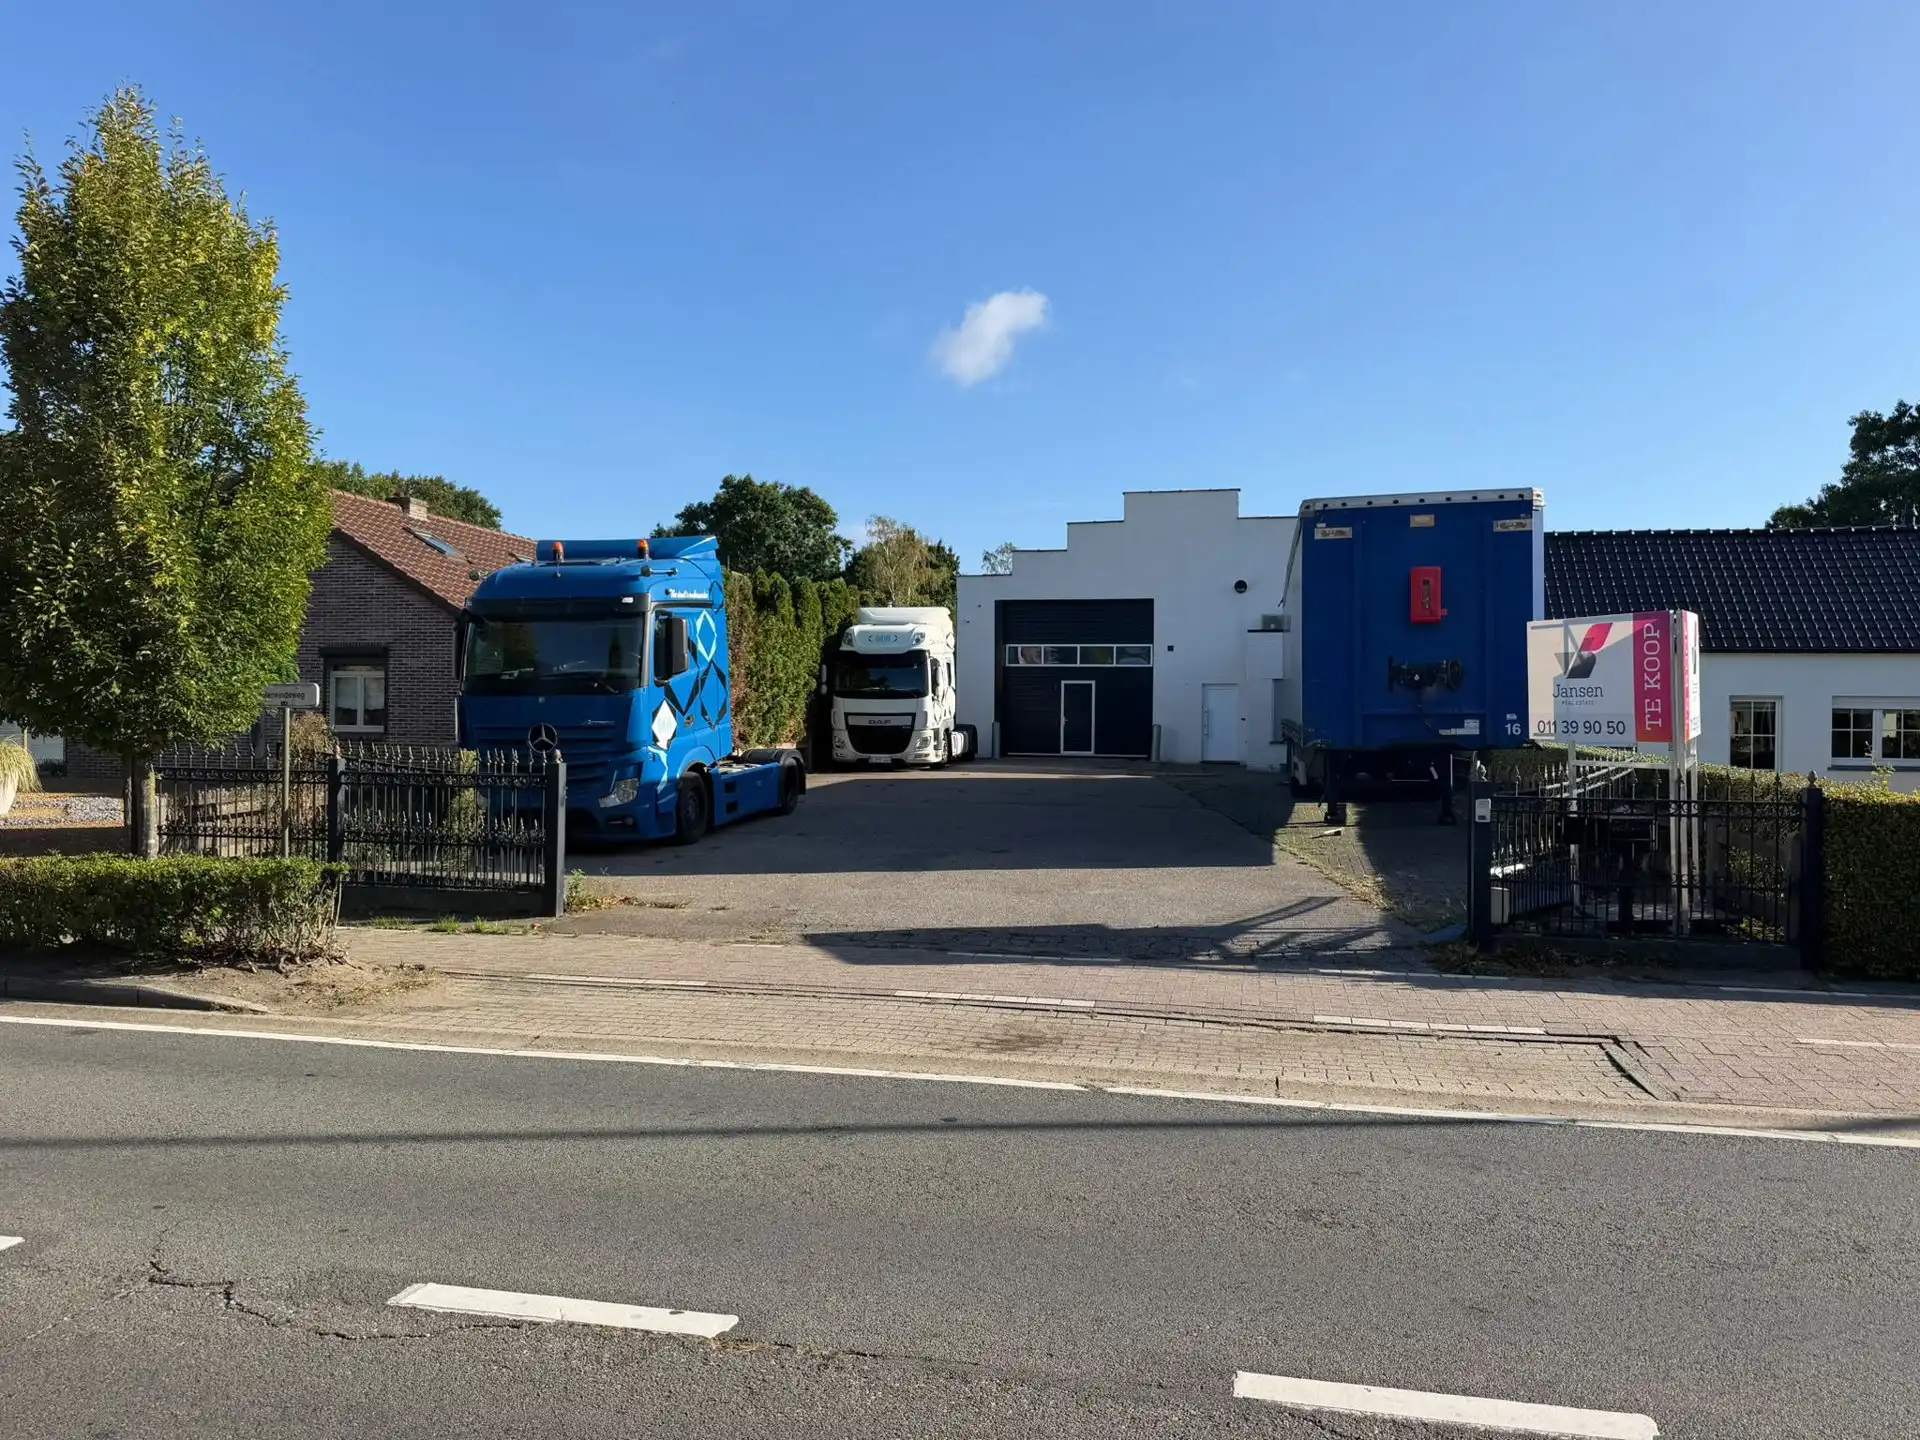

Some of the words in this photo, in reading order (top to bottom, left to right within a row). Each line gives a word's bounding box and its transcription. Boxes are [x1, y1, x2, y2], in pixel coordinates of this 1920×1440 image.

[1643, 622, 1661, 691] KOOP
[1552, 683, 1604, 698] Jansen
[1644, 698, 1662, 731] TE
[1504, 723, 1522, 735] 16
[1537, 720, 1557, 734] 011
[1561, 720, 1579, 735] 39
[1583, 720, 1602, 735] 90
[1606, 720, 1626, 735] 50
